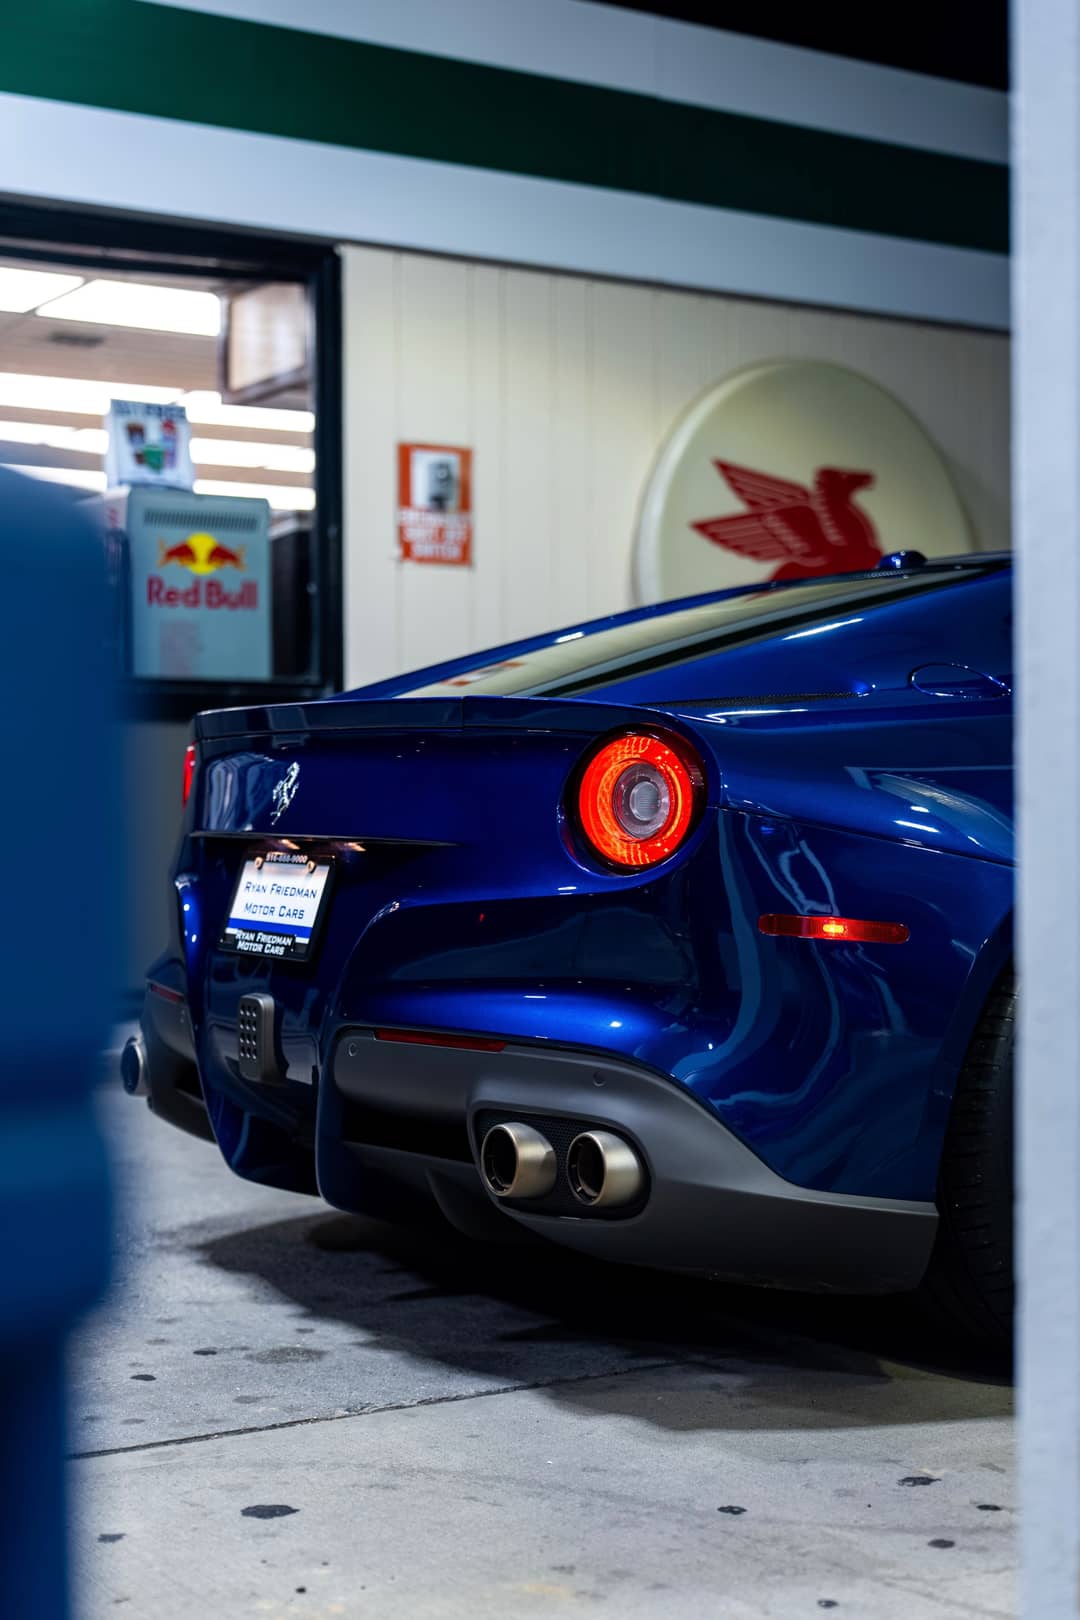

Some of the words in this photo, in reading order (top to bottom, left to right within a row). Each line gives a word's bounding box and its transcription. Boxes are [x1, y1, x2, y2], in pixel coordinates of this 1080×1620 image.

[147, 575, 201, 608] Red
[205, 579, 258, 611] Bull
[245, 881, 267, 894] RYAN
[270, 883, 318, 899] FRIEDMAN
[244, 902, 276, 917] MOTOR
[278, 905, 305, 920] CARS
[235, 929, 255, 942] RYAN
[256, 932, 293, 947] FRIEDMAN
[237, 941, 263, 954] MOTOR
[264, 943, 285, 955] CARS
